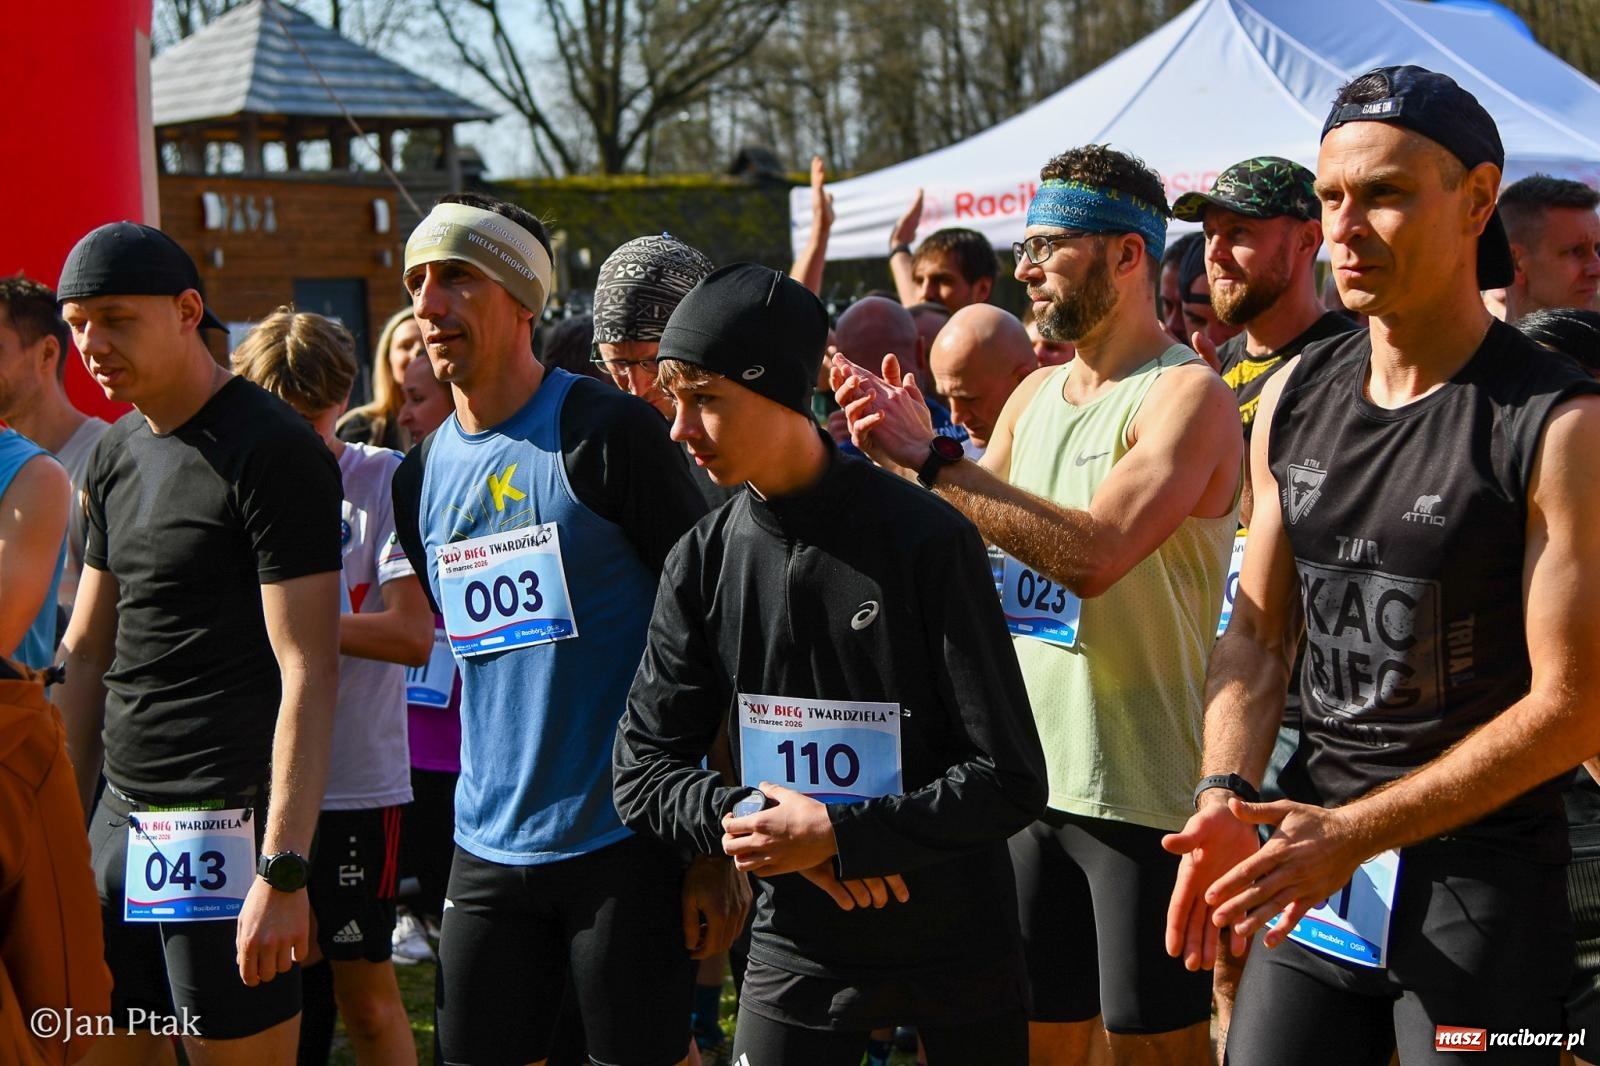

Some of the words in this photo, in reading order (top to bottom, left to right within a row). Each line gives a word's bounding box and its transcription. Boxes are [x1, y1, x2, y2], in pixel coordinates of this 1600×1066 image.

[468, 232, 499, 257] WIELKA
[500, 251, 536, 281] KROKIEW
[1401, 511, 1447, 527] ATTIQ
[464, 546, 487, 561] BIEG
[489, 534, 548, 556] TWARDZIELA
[453, 564, 473, 573] marzec
[474, 559, 488, 568] 2026
[465, 570, 543, 622] 003
[1017, 569, 1066, 614] 023
[749, 703, 770, 715] XIV
[774, 704, 803, 719] BIEG
[807, 707, 887, 722] TWARDZIELA
[758, 718, 784, 727] marzec
[784, 720, 803, 728] 2026
[777, 740, 860, 788] 110
[153, 821, 171, 832] BIEG
[174, 819, 242, 831] TWARDZIELA
[145, 850, 227, 892] 043
